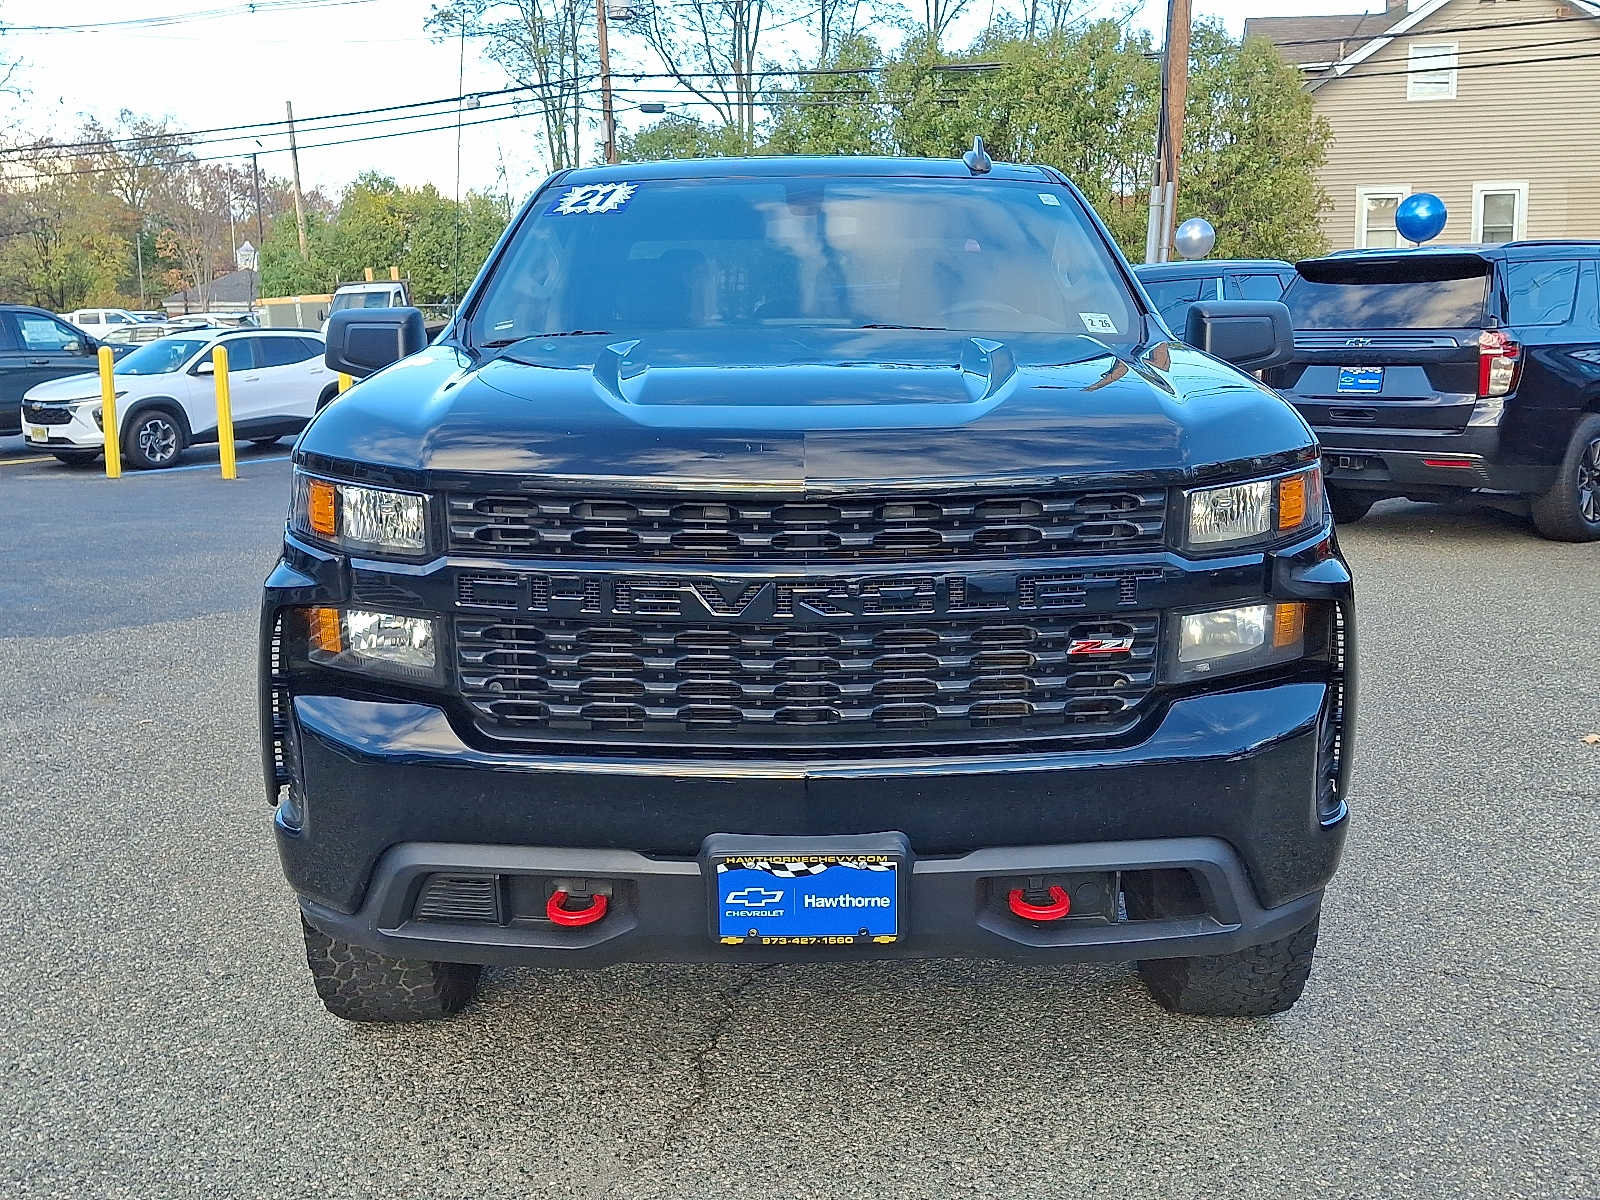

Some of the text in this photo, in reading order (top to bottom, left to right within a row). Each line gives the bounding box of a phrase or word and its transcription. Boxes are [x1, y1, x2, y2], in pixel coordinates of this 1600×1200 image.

[569, 188, 620, 208] 21
[1087, 318, 1111, 328] 2 26
[455, 568, 1164, 617] CHEVROLET
[1066, 638, 1135, 655] Z71
[725, 855, 888, 864] HAWTHORNECHEVY.COM
[803, 894, 890, 909] Hawthorne
[725, 909, 785, 917] CHEVROLET
